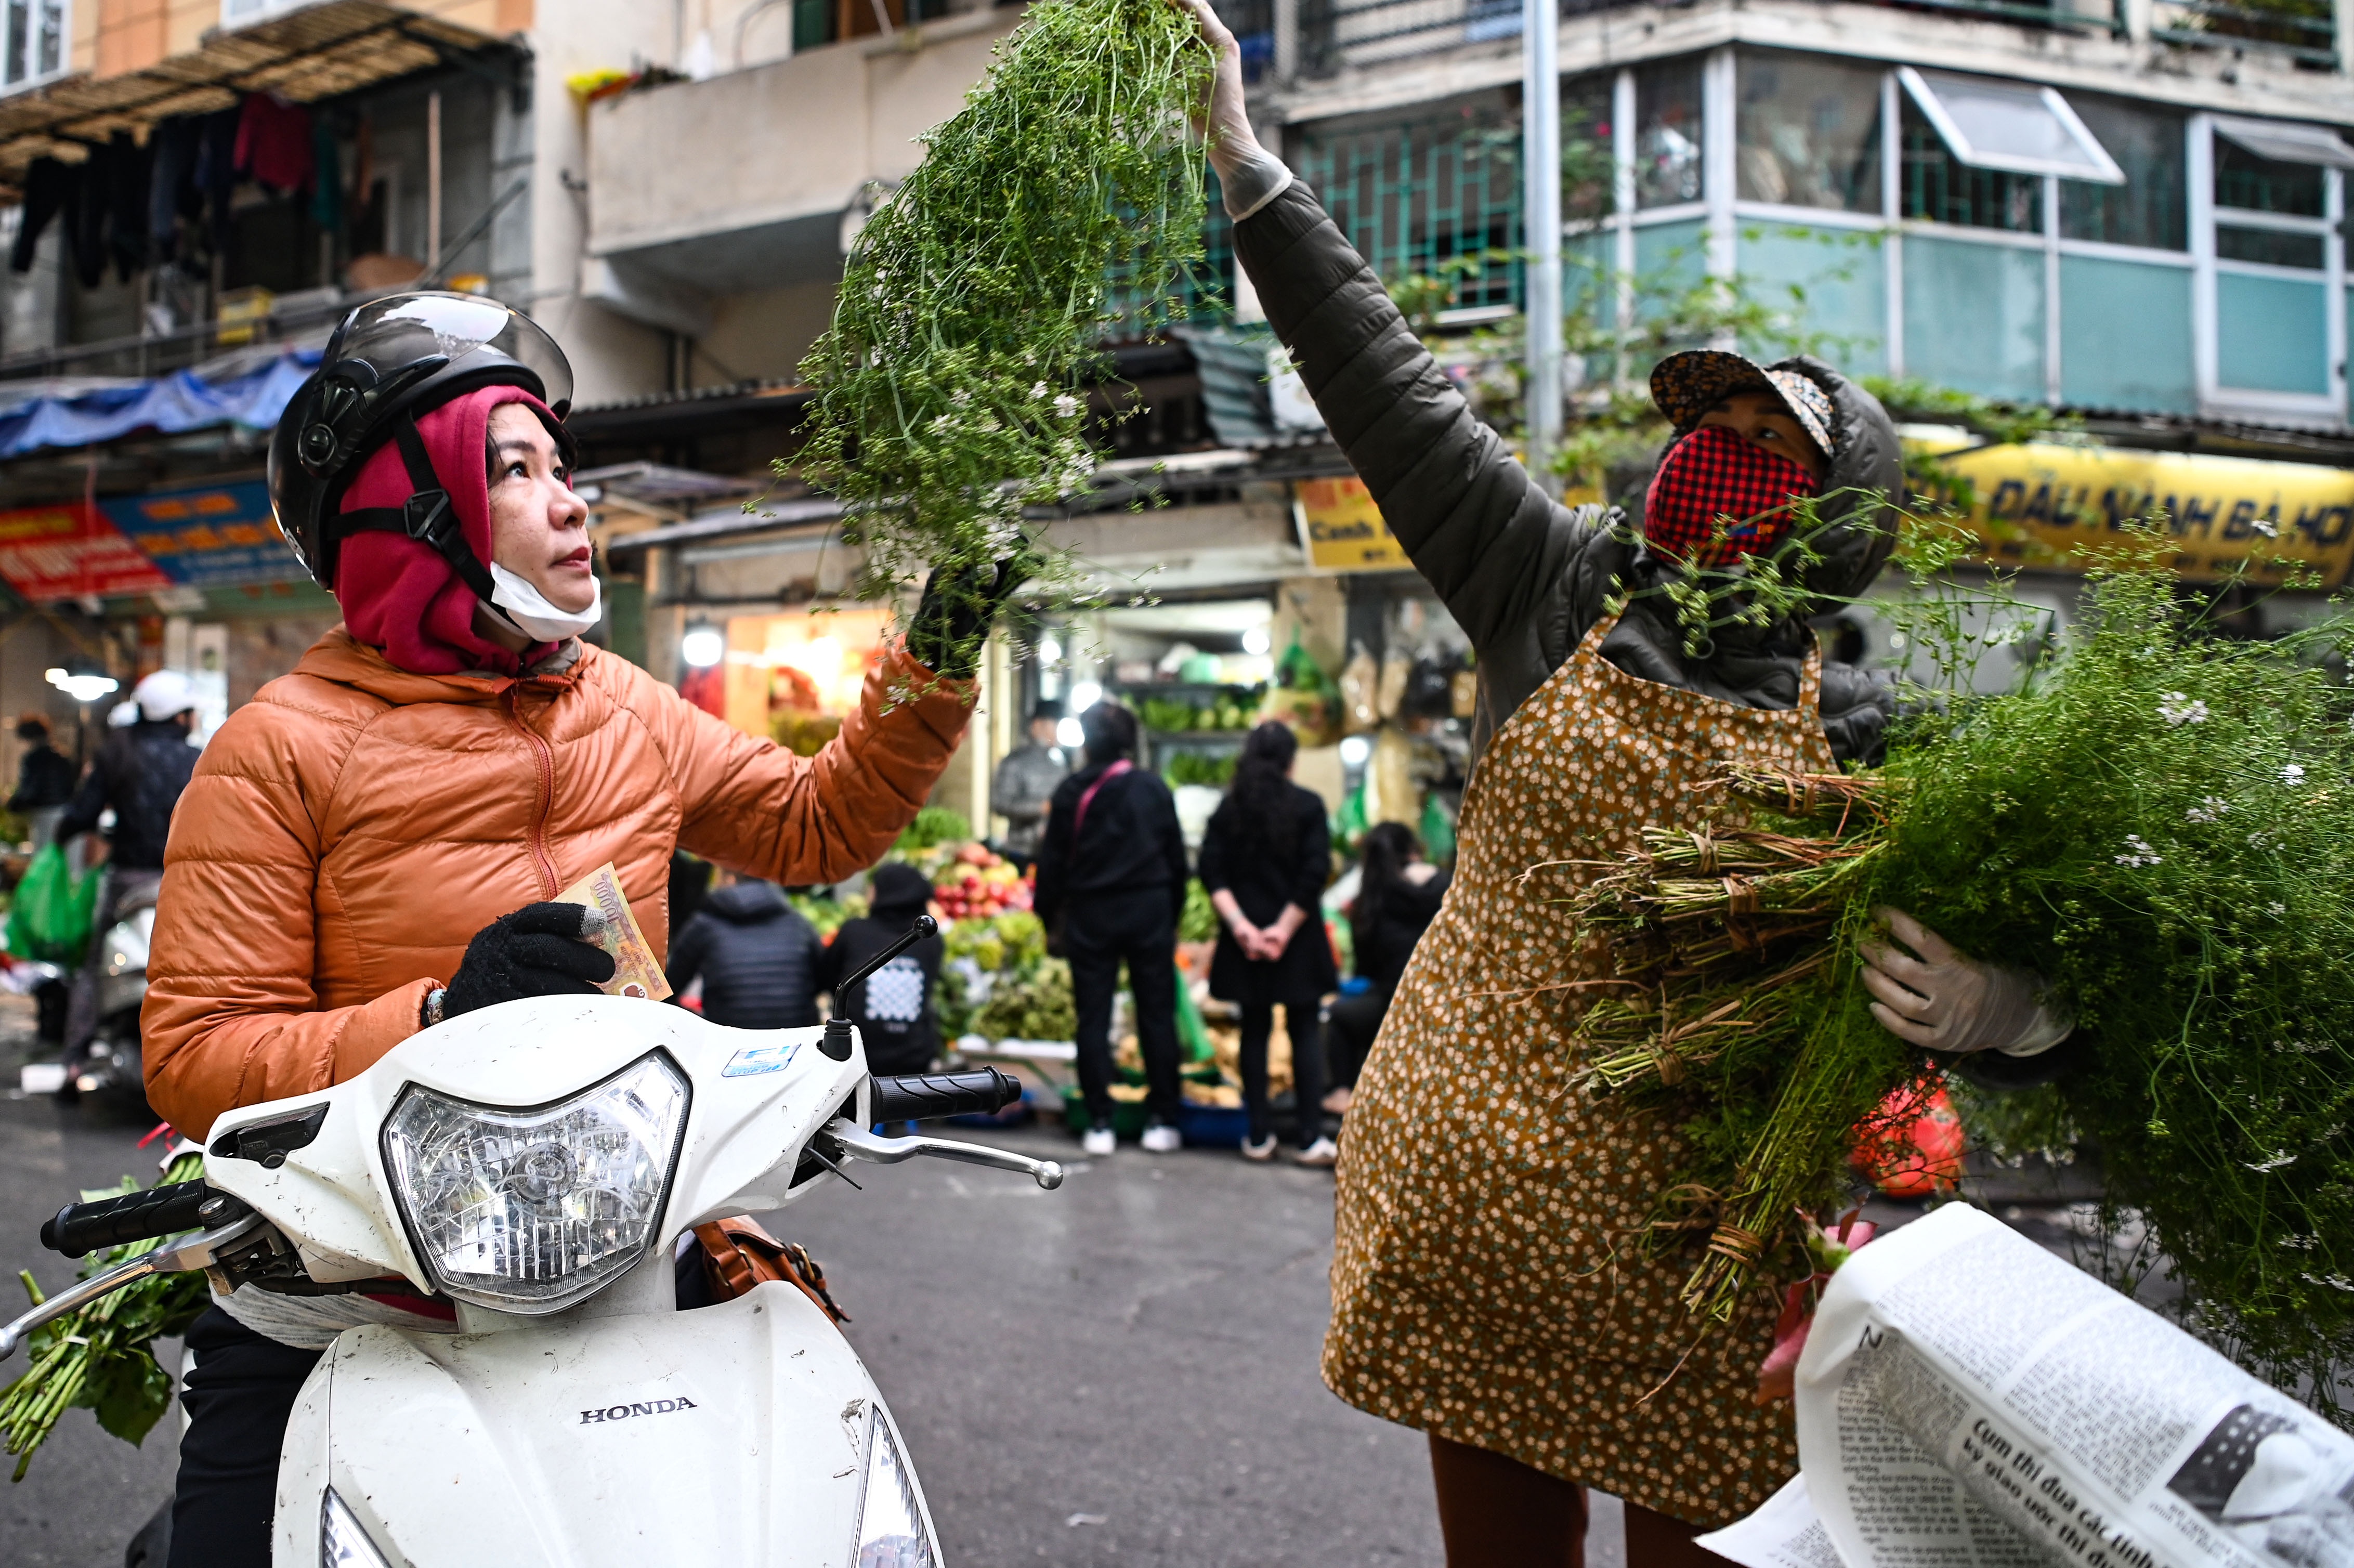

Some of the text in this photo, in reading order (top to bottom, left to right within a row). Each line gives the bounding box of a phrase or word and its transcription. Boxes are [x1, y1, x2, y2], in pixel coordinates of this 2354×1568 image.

[580, 1396, 698, 1425] HONDA
[1974, 1418, 2012, 1458] Cụm
[2013, 1450, 2045, 1482] thi
[2040, 1476, 2078, 1513] đua
[2080, 1509, 2110, 1540] các
[1984, 1461, 2022, 1499] giao
[2058, 1524, 2089, 1554] thi
